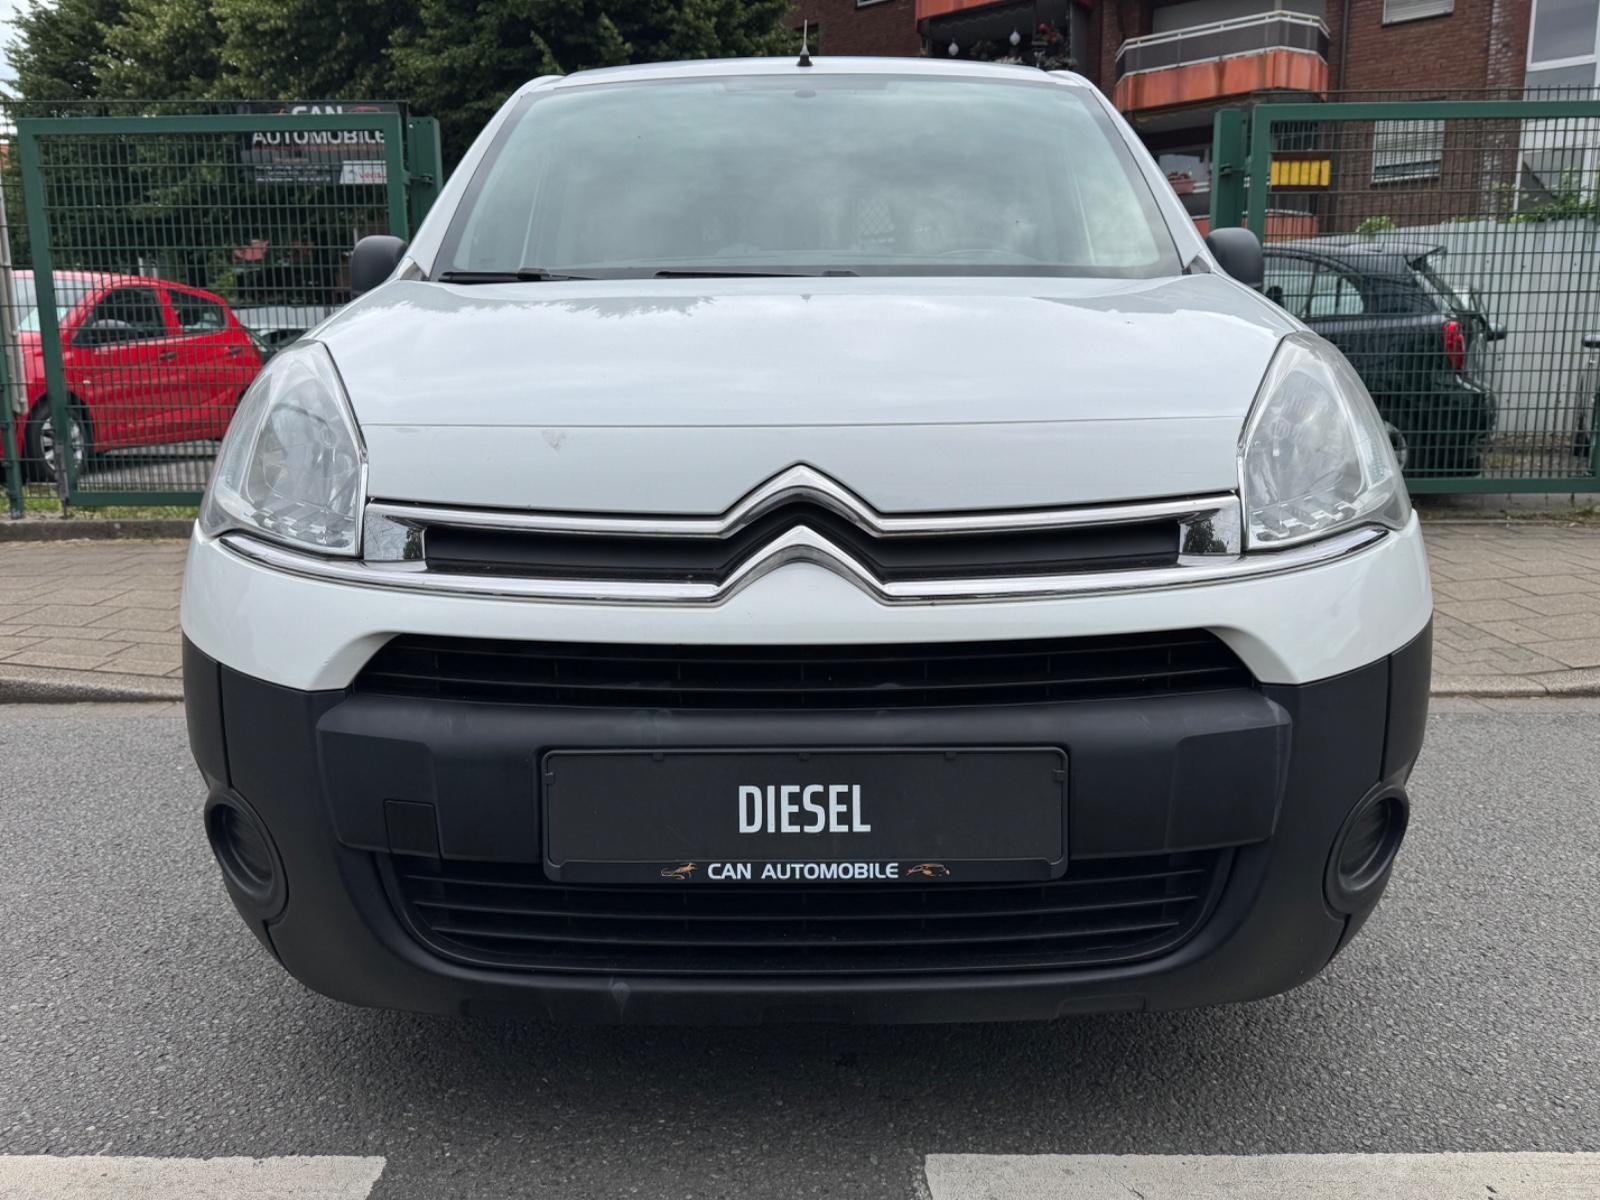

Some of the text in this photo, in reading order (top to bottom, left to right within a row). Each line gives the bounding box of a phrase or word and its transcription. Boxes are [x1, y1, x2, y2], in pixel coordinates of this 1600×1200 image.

[738, 784, 872, 834] DIESEL
[707, 862, 899, 880] CAN AUTOMOBILE
